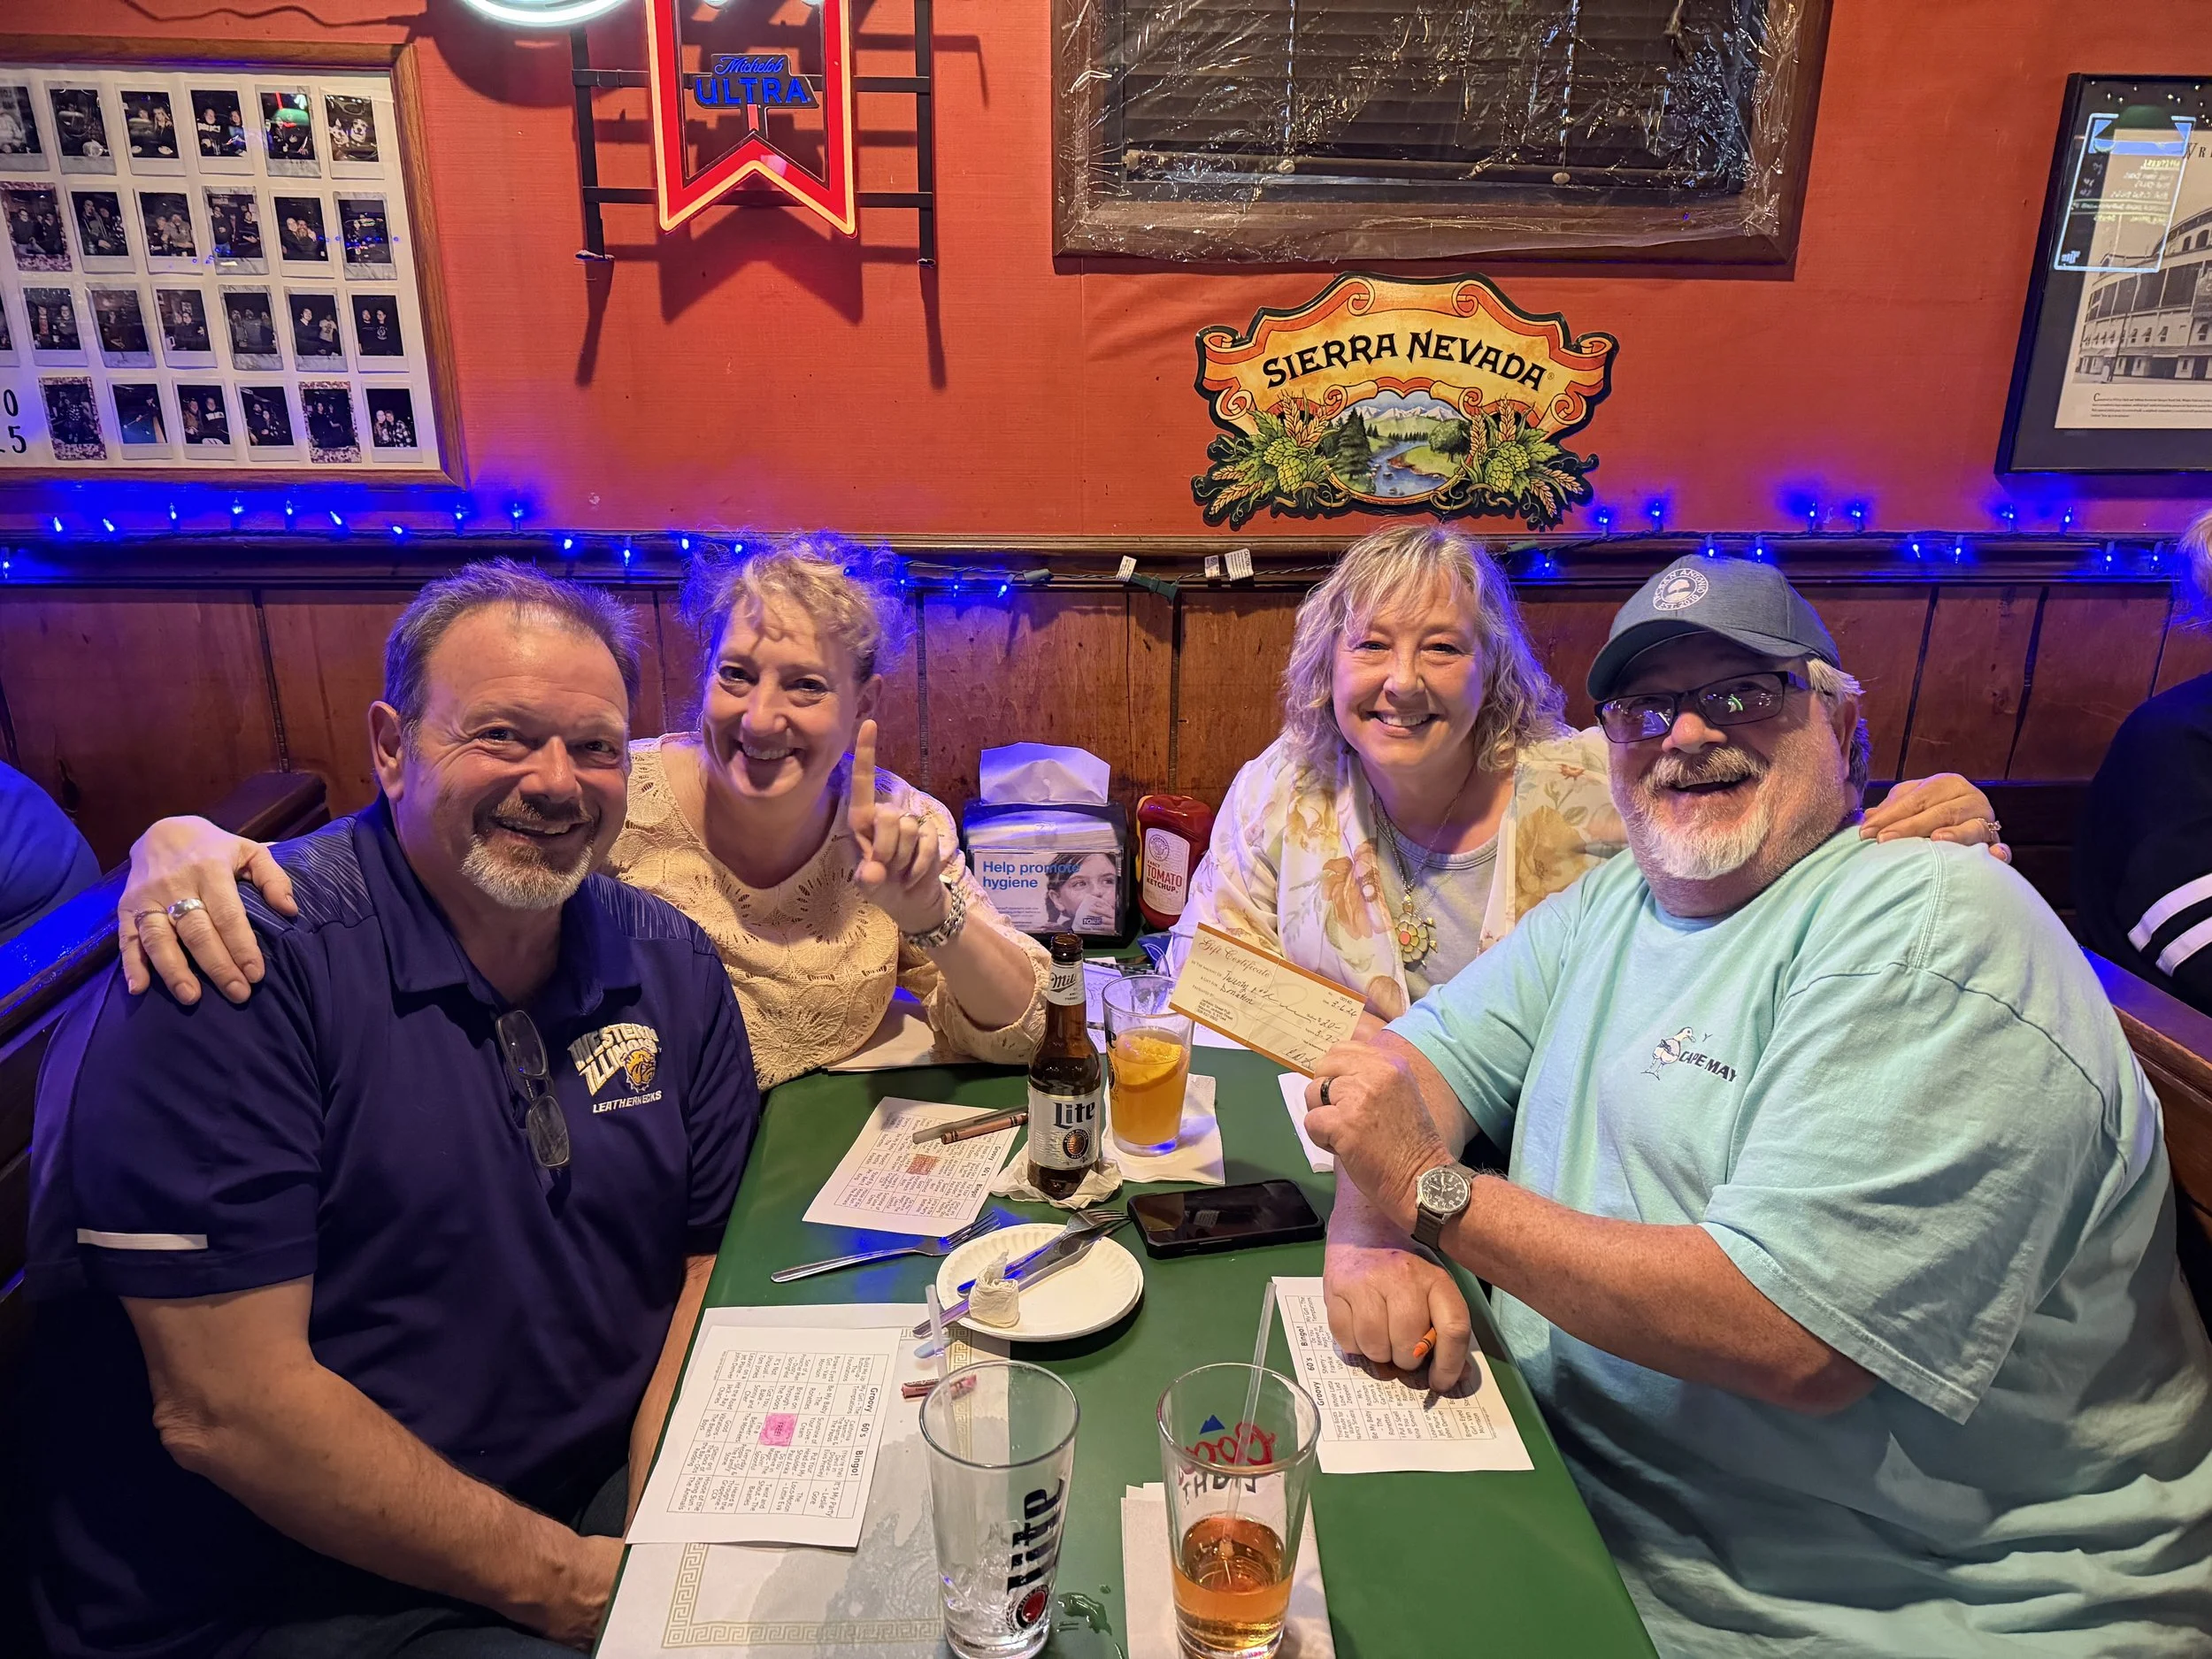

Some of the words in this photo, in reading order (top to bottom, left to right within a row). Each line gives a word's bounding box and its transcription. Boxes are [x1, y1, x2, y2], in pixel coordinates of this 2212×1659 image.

[714, 56, 786, 75] Michelob
[695, 77, 809, 104] ULTRA
[1263, 332, 1398, 388] SIERRA
[1407, 328, 1548, 391] NEVADA
[983, 861, 1015, 875] Help
[1020, 862, 1080, 876] promote
[1148, 864, 1183, 887] TOMATO
[983, 877, 1039, 891] hygiene
[1147, 878, 1176, 893] KETCHUP
[1199, 937, 1222, 957] Gift
[1224, 947, 1271, 979] Certificate
[567, 1022, 660, 1071] WESTERN
[1678, 1050, 1708, 1067] CAPE
[1704, 1058, 1737, 1082] MAY
[592, 1090, 663, 1114] LEATHERNECKS
[1053, 1102, 1095, 1130] Lite
[1296, 1325, 1310, 1346] Bingo!
[1305, 1357, 1314, 1371] 60's
[803, 1387, 815, 1409] Ronettes
[864, 1387, 878, 1412] Groovy
[1311, 1381, 1326, 1405] Groovy
[819, 1402, 829, 1414] Baby
[1363, 1410, 1374, 1422] Baby
[859, 1423, 871, 1437] 60's
[1374, 1417, 1384, 1426] The
[1381, 1413, 1395, 1434] Ronettes
[849, 1450, 864, 1476] Bingo!
[810, 1491, 819, 1504] Gore
[818, 1493, 828, 1509] Leslie
[829, 1491, 838, 1500] My
[825, 1501, 836, 1517] Party
[1007, 1477, 1066, 1595] Lite
